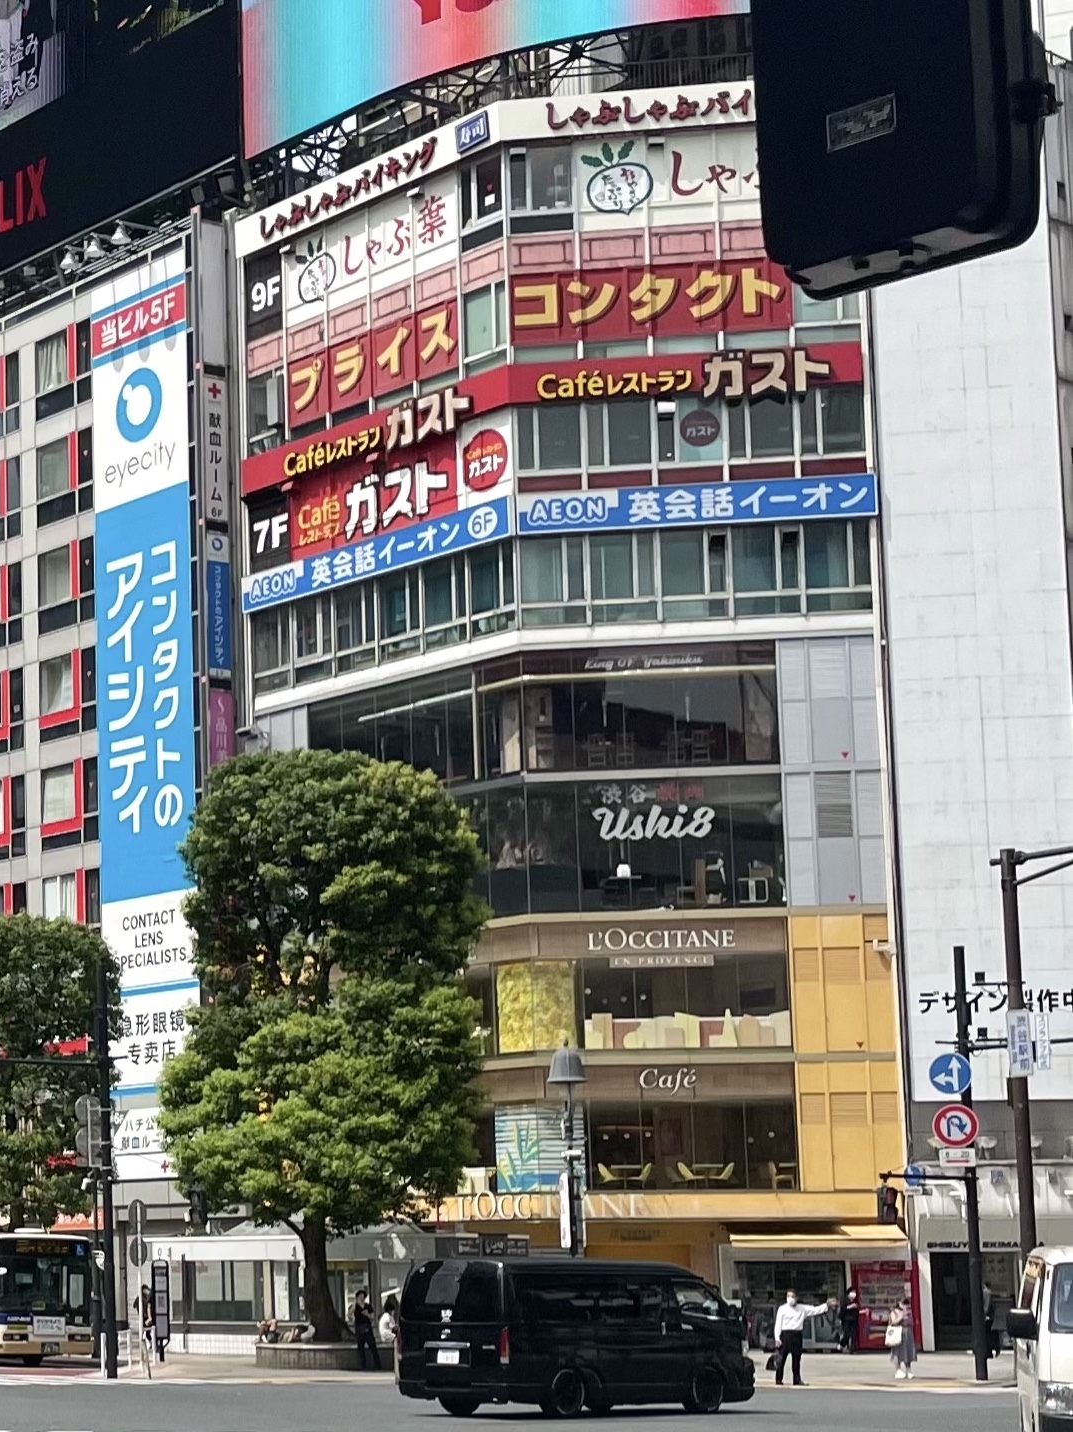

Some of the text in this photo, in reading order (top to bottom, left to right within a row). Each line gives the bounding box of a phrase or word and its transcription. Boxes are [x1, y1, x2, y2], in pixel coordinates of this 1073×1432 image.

[259, 136, 438, 242] しゃぶしゃぶバイキング
[672, 150, 760, 197] しゃ
[344, 195, 446, 276] しゃぶ葉
[251, 275, 281, 312] 9F
[514, 267, 781, 327] コンタクト
[101, 292, 176, 348] 当ビル5F
[292, 309, 456, 411] プライス
[704, 351, 829, 398] ガスト
[386, 388, 470, 449] ガスト
[104, 440, 176, 488] eyecity
[209, 412, 222, 503] 献血ルーム
[469, 454, 503, 479] ガスト
[298, 495, 341, 529] Café
[344, 461, 447, 539] ガスト
[530, 481, 868, 524] AEON 英会話イーオン
[250, 510, 494, 602] AEON 英会話イーオン 6F
[253, 513, 288, 554] 7F
[106, 551, 149, 834] アイシティ
[151, 540, 183, 827] コンタクトの
[592, 804, 716, 841] Ushi8
[122, 909, 176, 931] CONTACT
[135, 931, 163, 949] LENS
[588, 927, 736, 951] L'OCCITANE
[639, 1067, 696, 1093] Café
